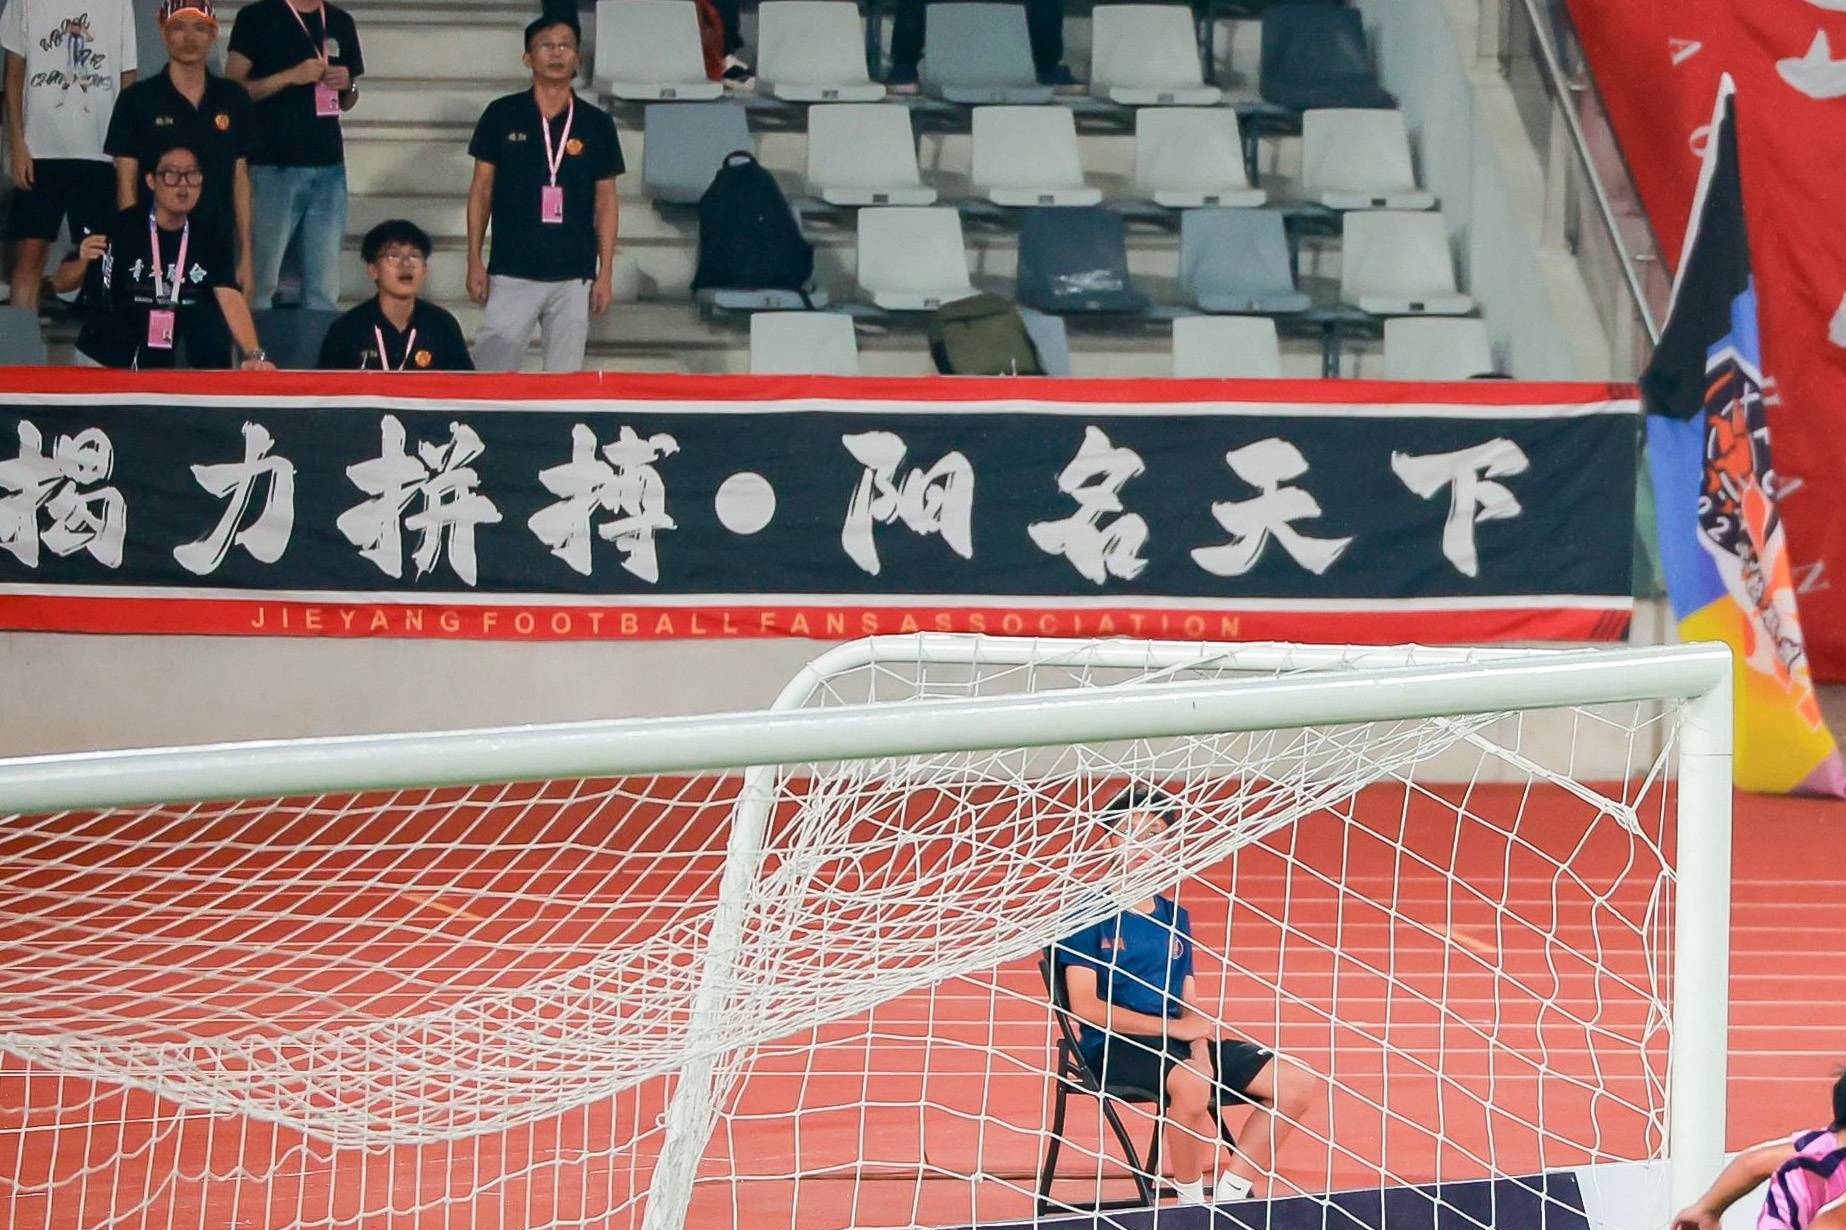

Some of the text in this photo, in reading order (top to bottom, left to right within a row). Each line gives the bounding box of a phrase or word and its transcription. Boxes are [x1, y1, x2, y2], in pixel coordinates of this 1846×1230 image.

[251, 607, 1240, 638] JIEYANG FOOTBALL FANS ASSOCIATION
